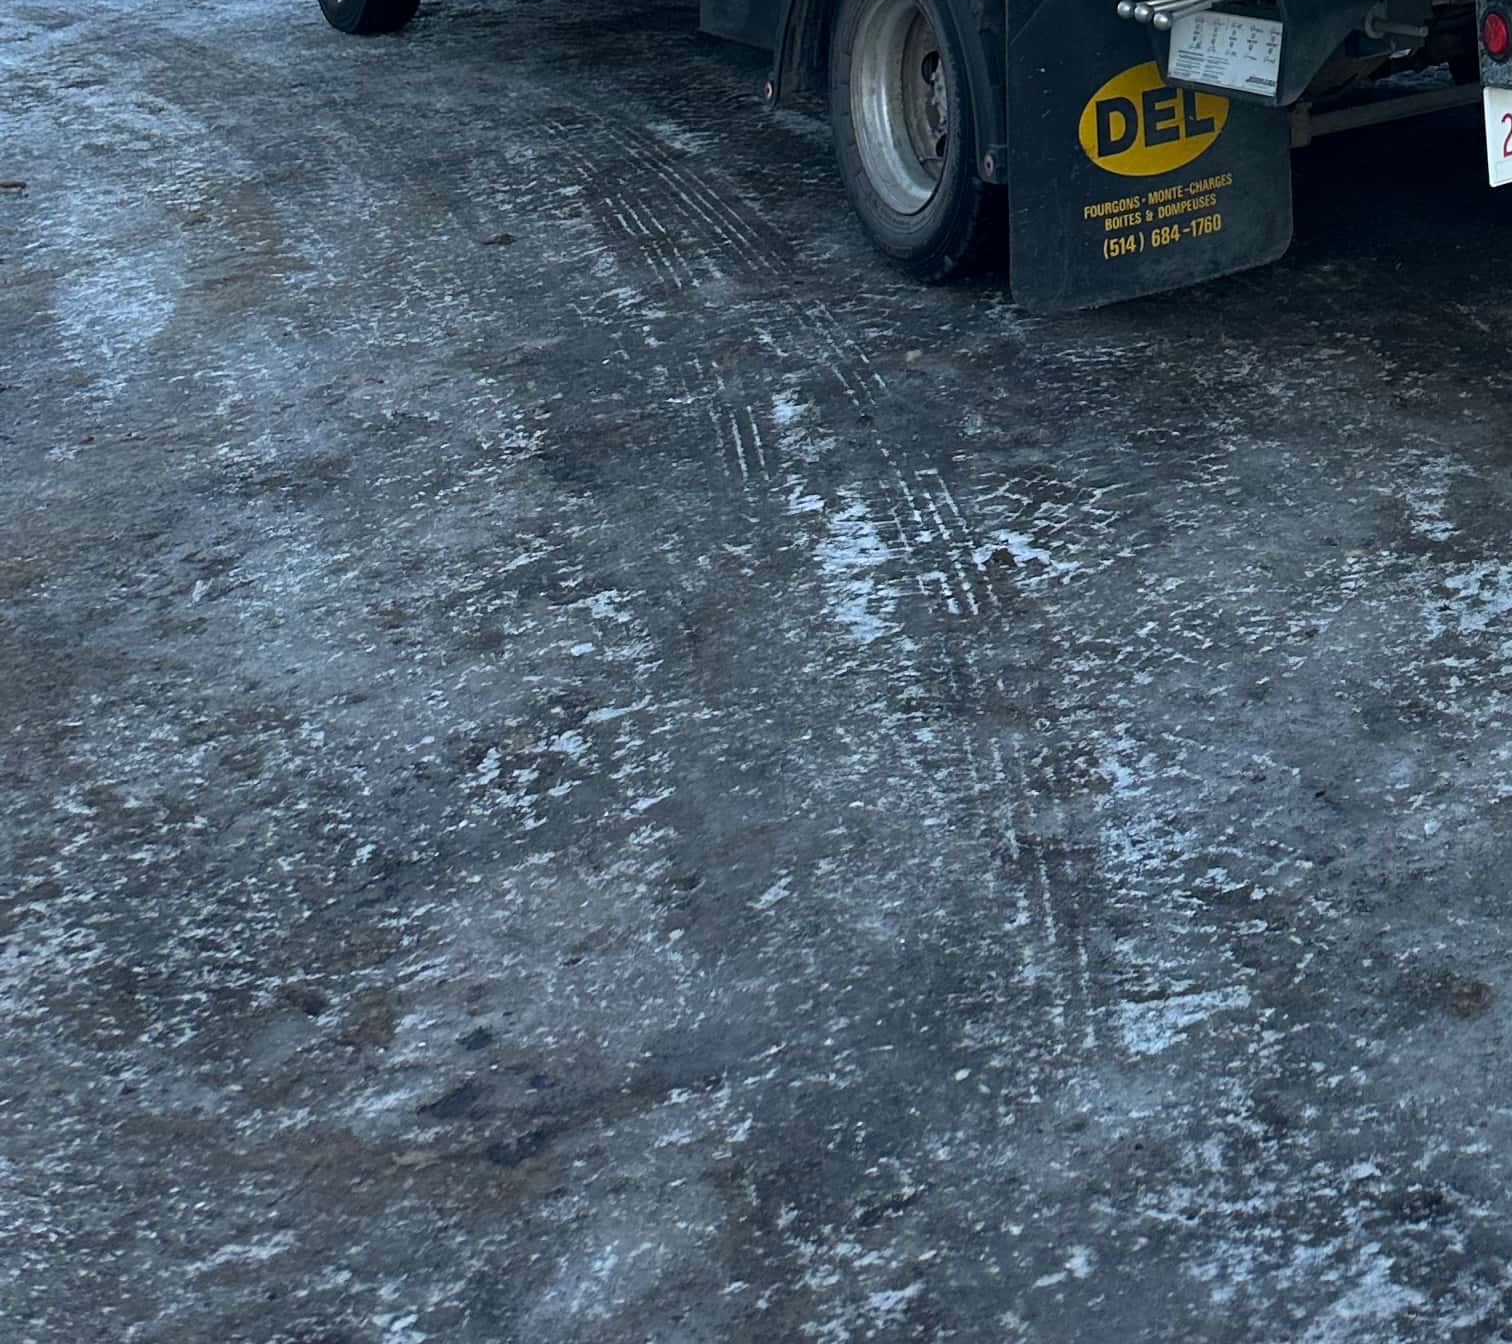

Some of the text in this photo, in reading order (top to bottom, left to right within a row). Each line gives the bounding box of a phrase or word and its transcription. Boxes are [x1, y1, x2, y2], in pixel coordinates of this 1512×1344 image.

[1096, 87, 1216, 158] DEL
[1084, 173, 1233, 220] FOURGONS MONTE-CHARGES
[1104, 211, 1142, 231] BOITES
[1158, 193, 1217, 220] DOMPEUSES
[1103, 213, 1222, 260] (514) 684-1760
